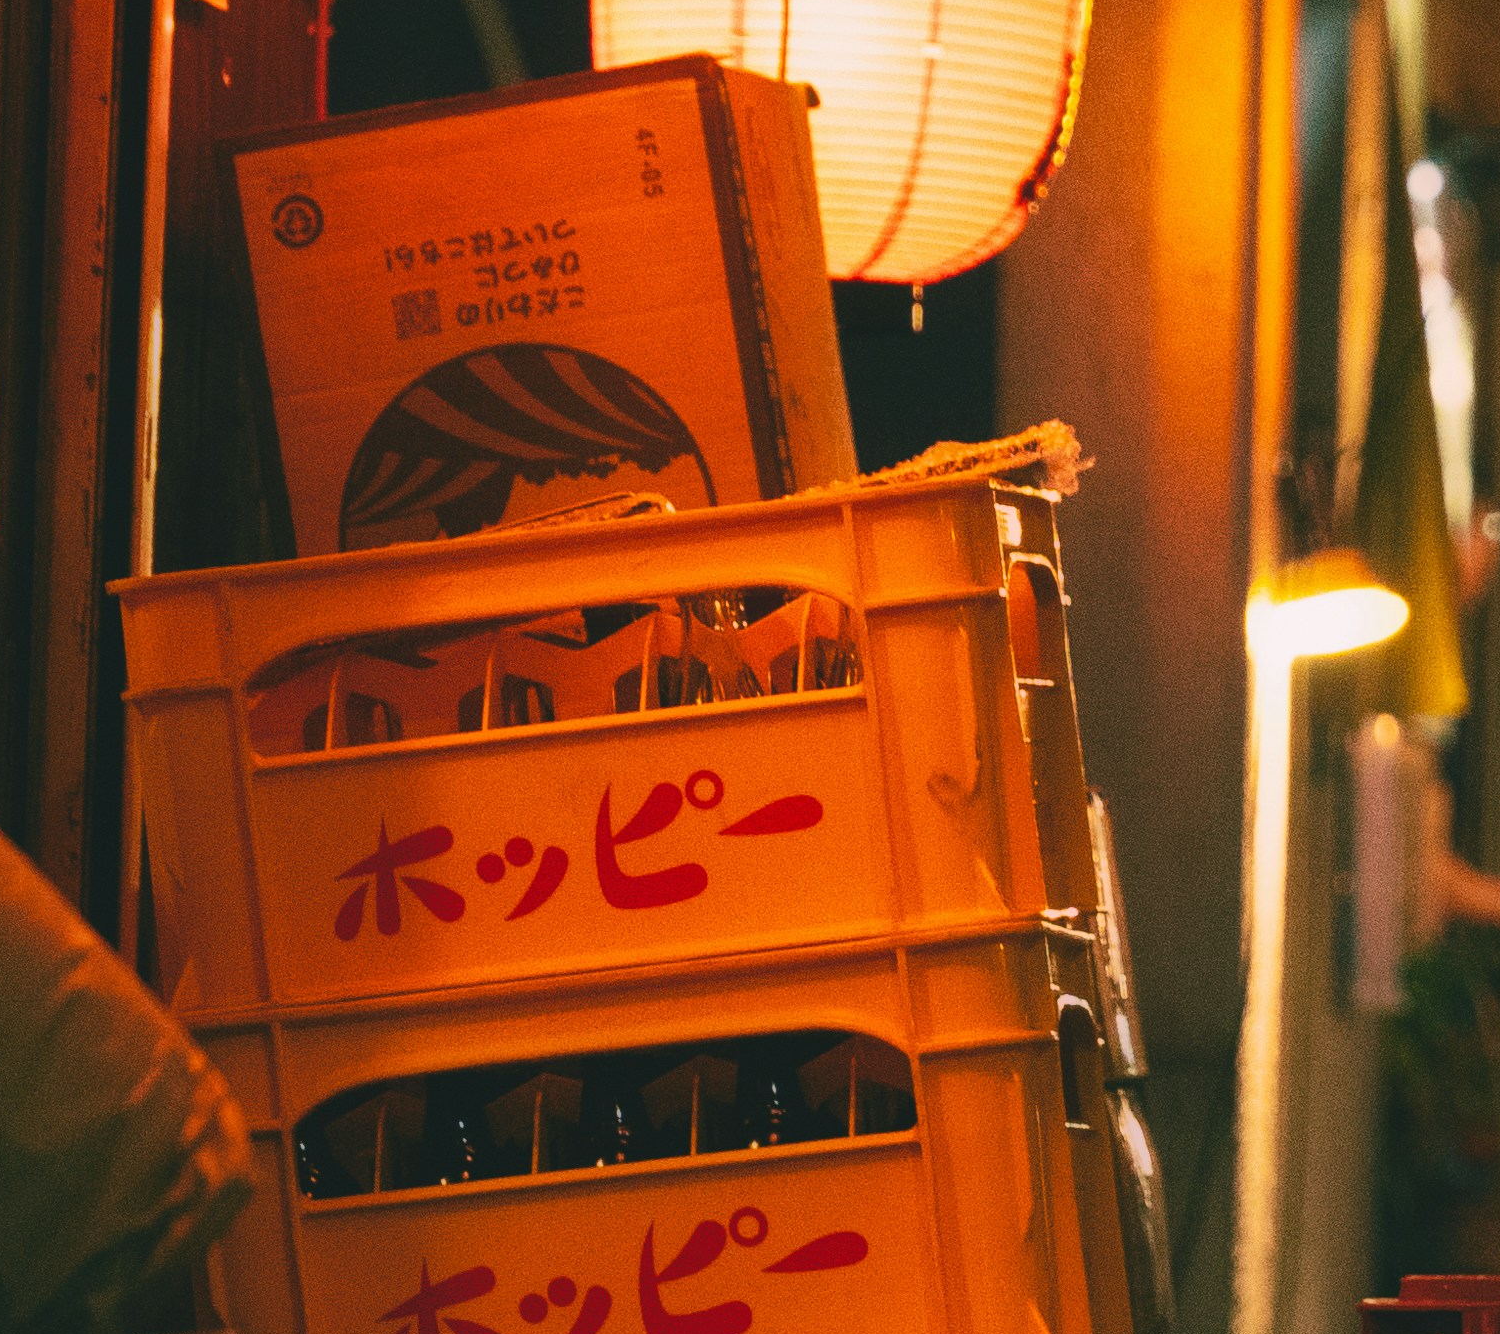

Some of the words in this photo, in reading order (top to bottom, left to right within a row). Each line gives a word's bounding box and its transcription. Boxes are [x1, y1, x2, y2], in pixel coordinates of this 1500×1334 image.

[456, 284, 586, 327] こだわりの
[333, 769, 823, 942] ホッピー
